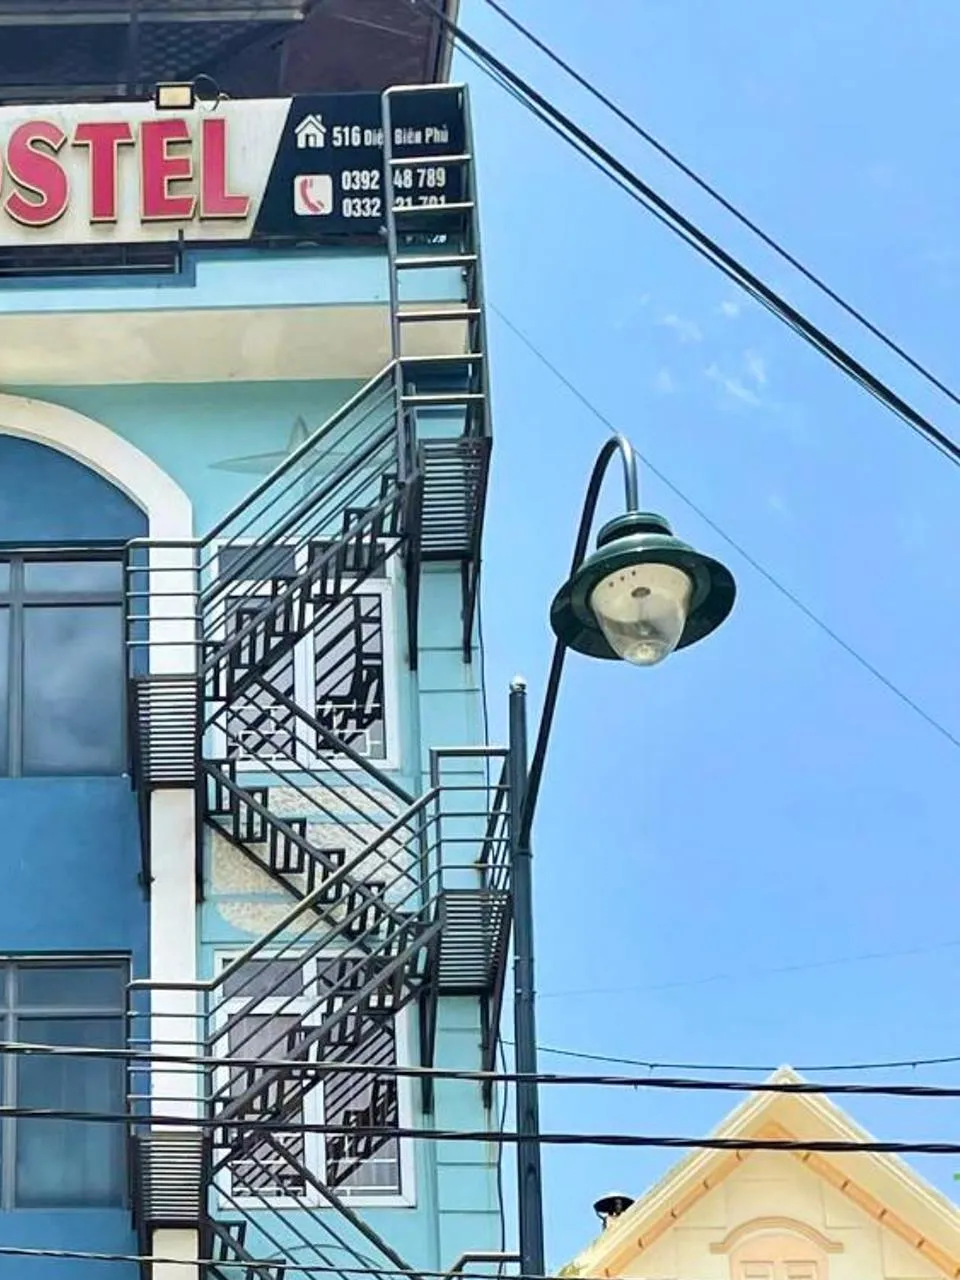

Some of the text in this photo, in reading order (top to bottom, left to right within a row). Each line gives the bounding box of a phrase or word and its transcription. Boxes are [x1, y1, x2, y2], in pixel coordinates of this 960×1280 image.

[332, 126, 361, 147] 516
[425, 123, 449, 144] Phủ
[341, 167, 446, 191] 0392 48 789
[342, 197, 382, 218] 0332
